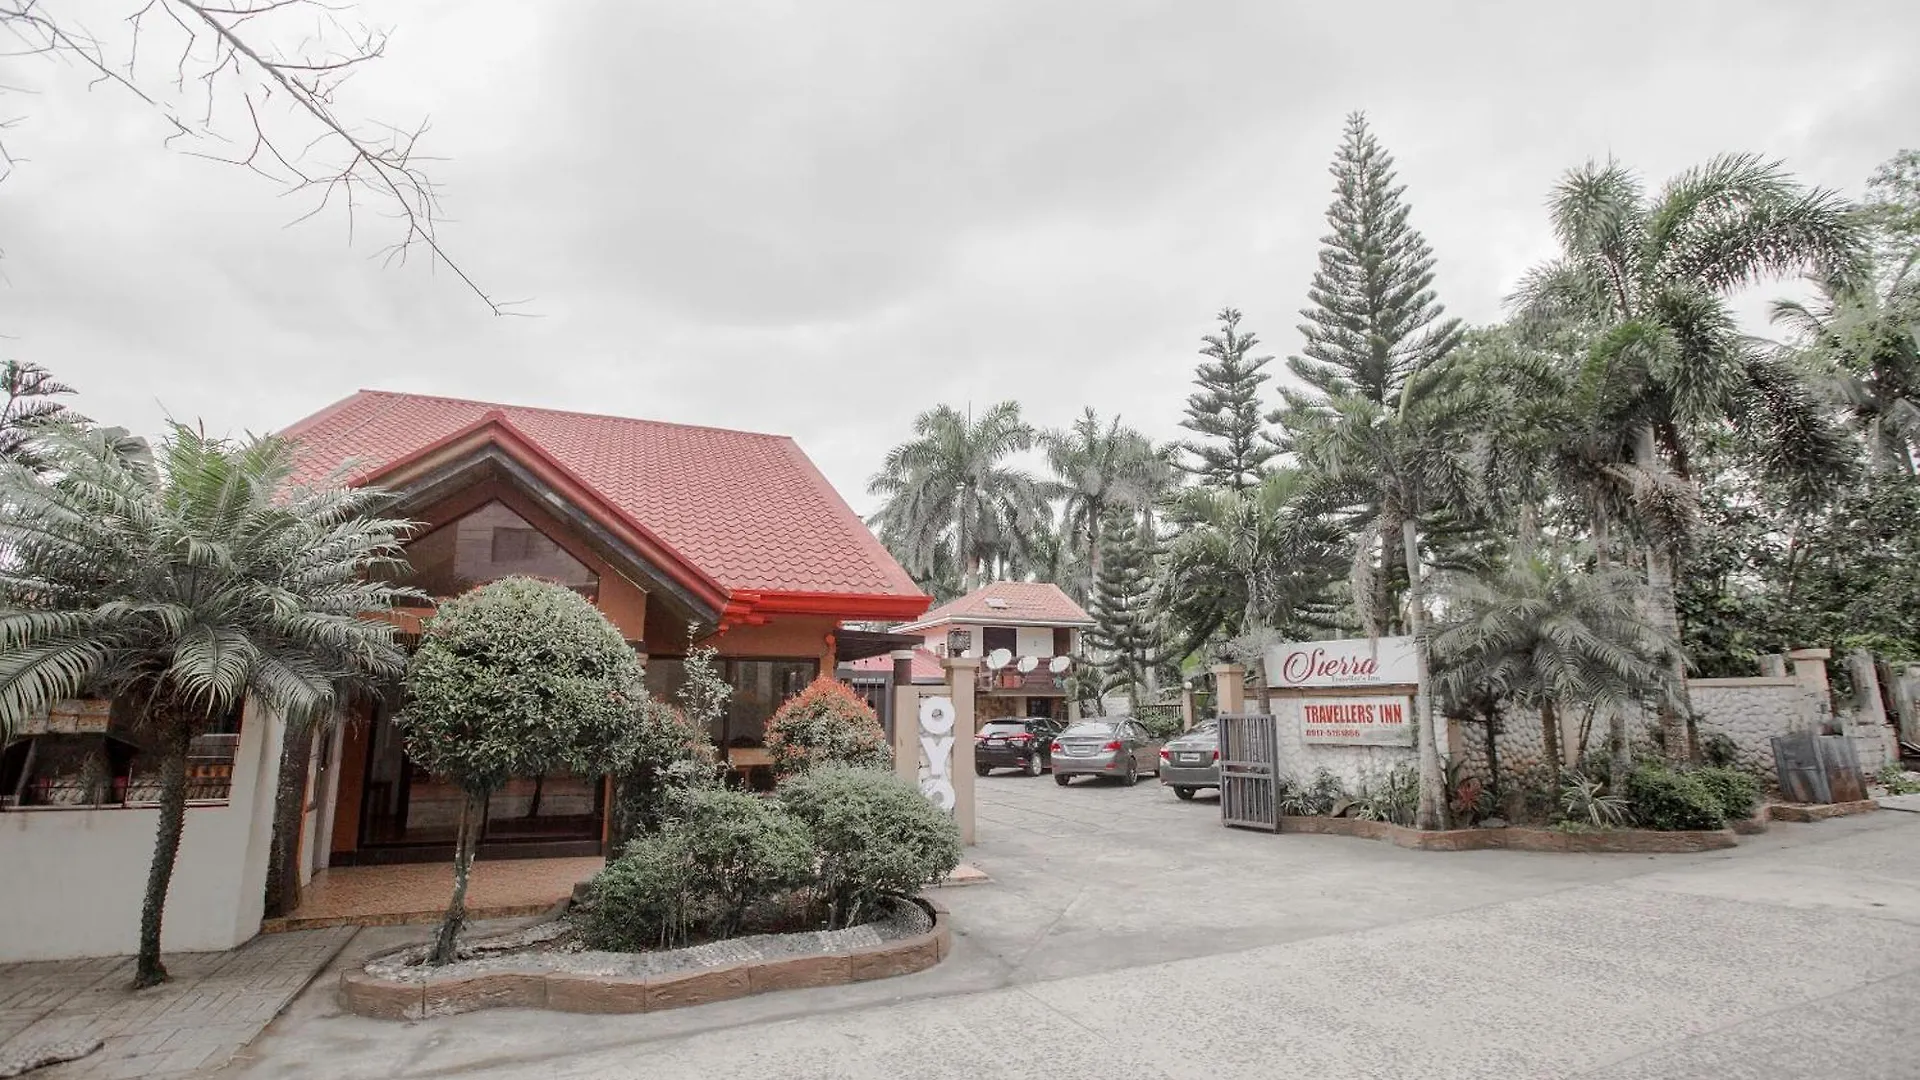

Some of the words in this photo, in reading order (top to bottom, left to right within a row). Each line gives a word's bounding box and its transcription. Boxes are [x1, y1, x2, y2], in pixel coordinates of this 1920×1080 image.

[1283, 647, 1379, 684] Sierra
[1304, 704, 1376, 724] TRAVELLERS'
[1379, 703, 1402, 723] INN
